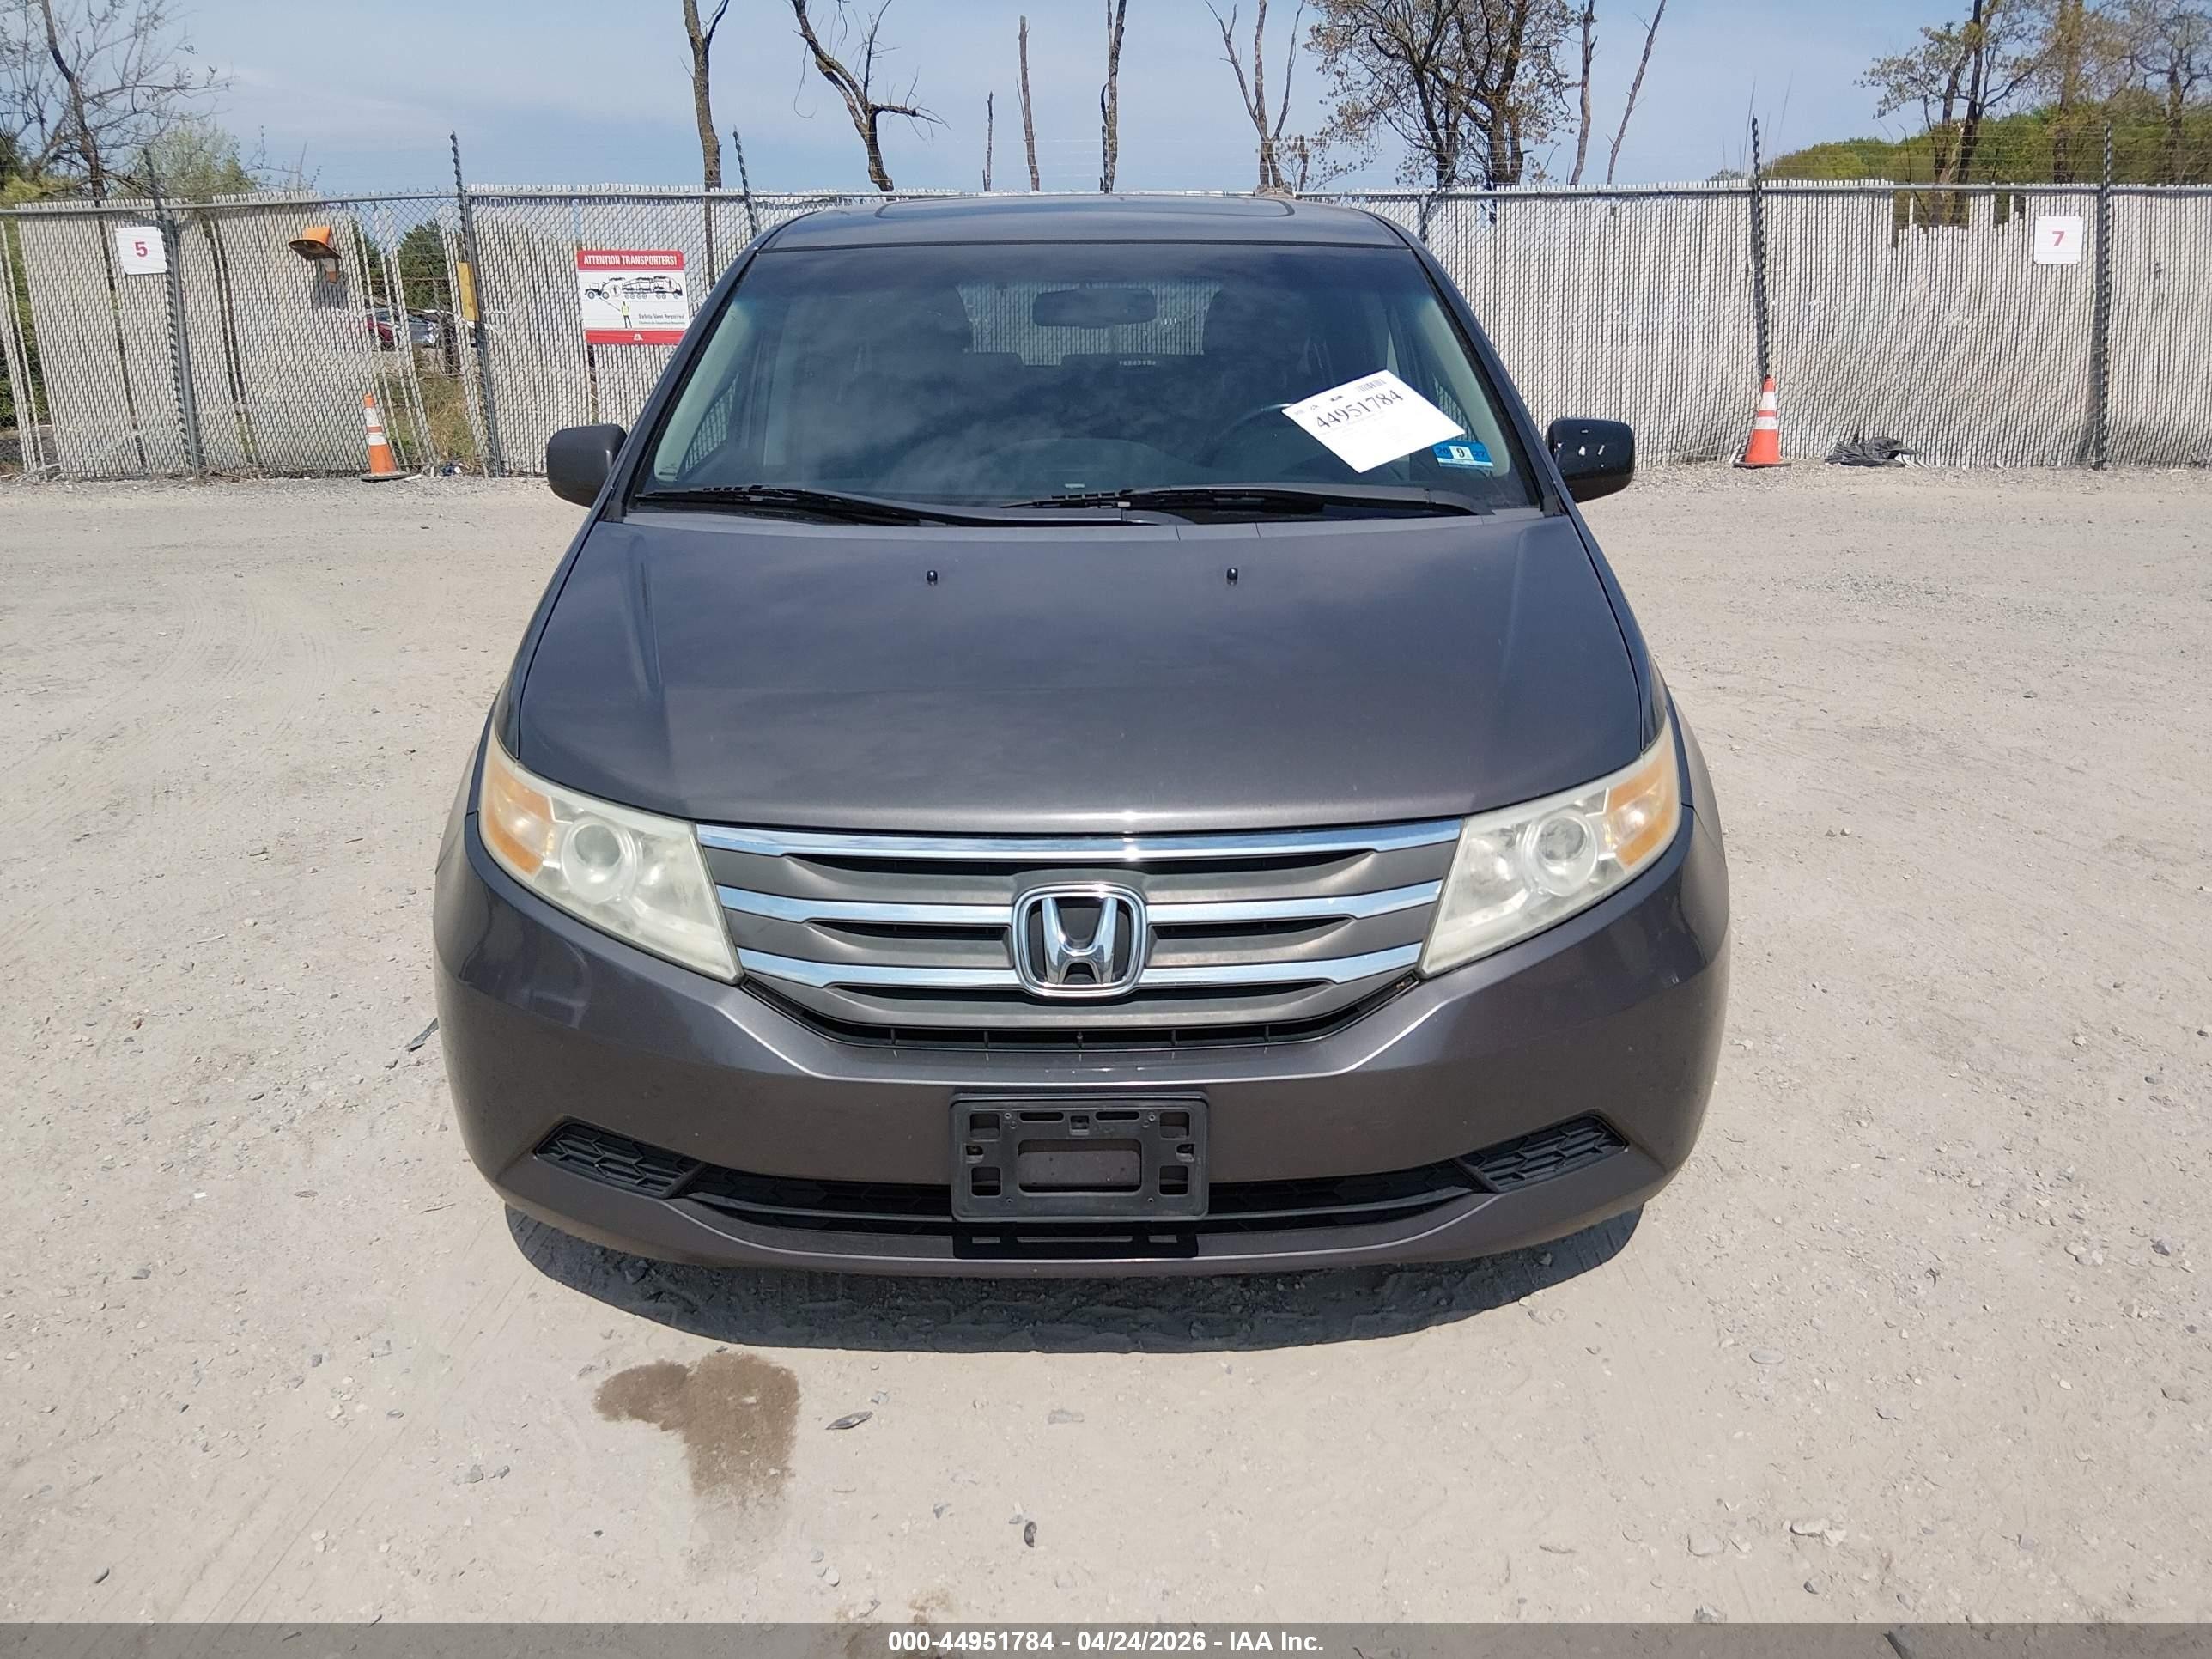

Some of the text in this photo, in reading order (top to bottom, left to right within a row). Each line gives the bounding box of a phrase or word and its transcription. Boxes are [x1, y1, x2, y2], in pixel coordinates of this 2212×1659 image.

[2052, 230, 2065, 247] 7
[135, 241, 148, 258] 5
[584, 255, 678, 266] ATTENTION TRANSPORTERS!
[1316, 389, 1404, 428] 44951784
[1455, 447, 1465, 459] 9
